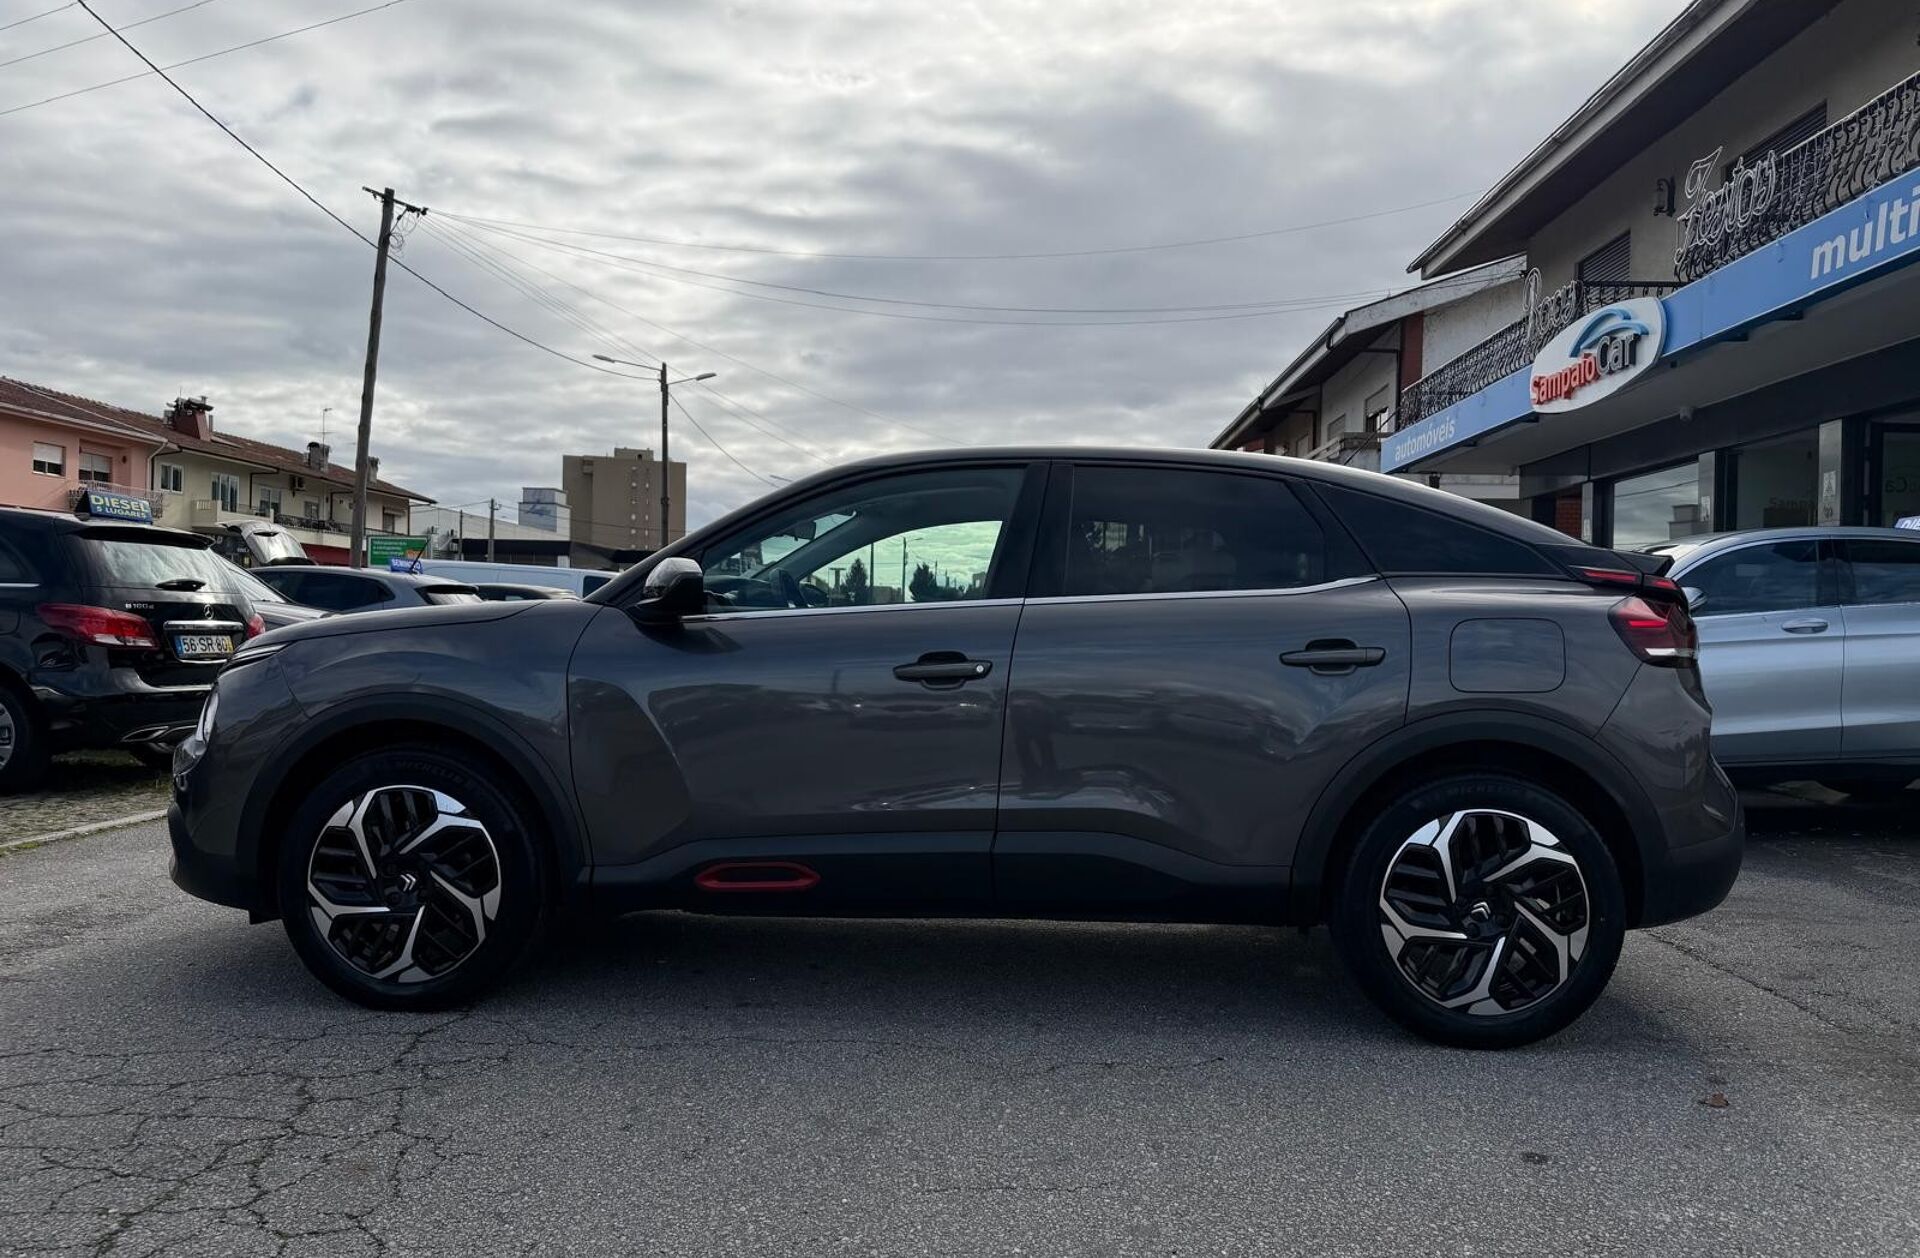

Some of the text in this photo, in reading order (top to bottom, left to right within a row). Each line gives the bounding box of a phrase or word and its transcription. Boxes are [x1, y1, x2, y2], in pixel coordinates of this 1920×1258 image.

[1811, 184, 1920, 280] multi
[1395, 416, 1456, 462] automóveis
[90, 495, 149, 513] DIESEL
